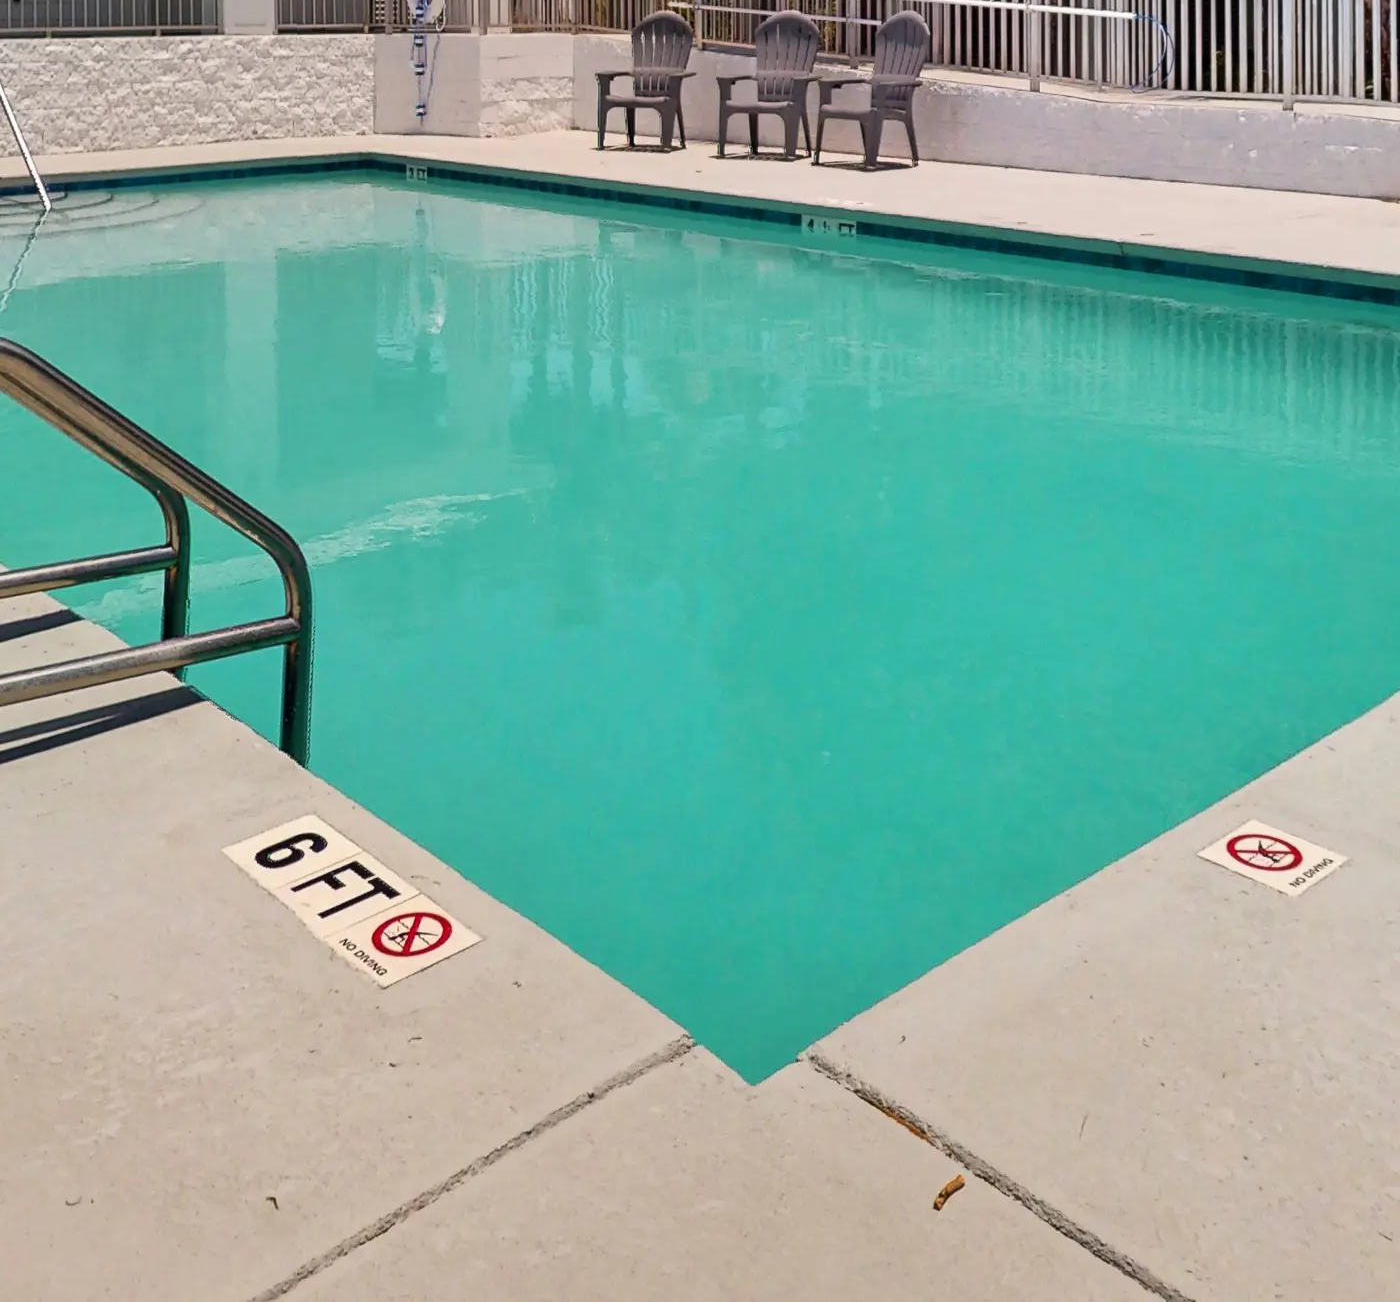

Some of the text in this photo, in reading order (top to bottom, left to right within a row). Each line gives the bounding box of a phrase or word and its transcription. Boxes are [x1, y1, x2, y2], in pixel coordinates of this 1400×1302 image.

[255, 832, 401, 919] 6 FT
[1288, 857, 1334, 888] NO DIVING
[339, 938, 388, 976] NO DIVING
